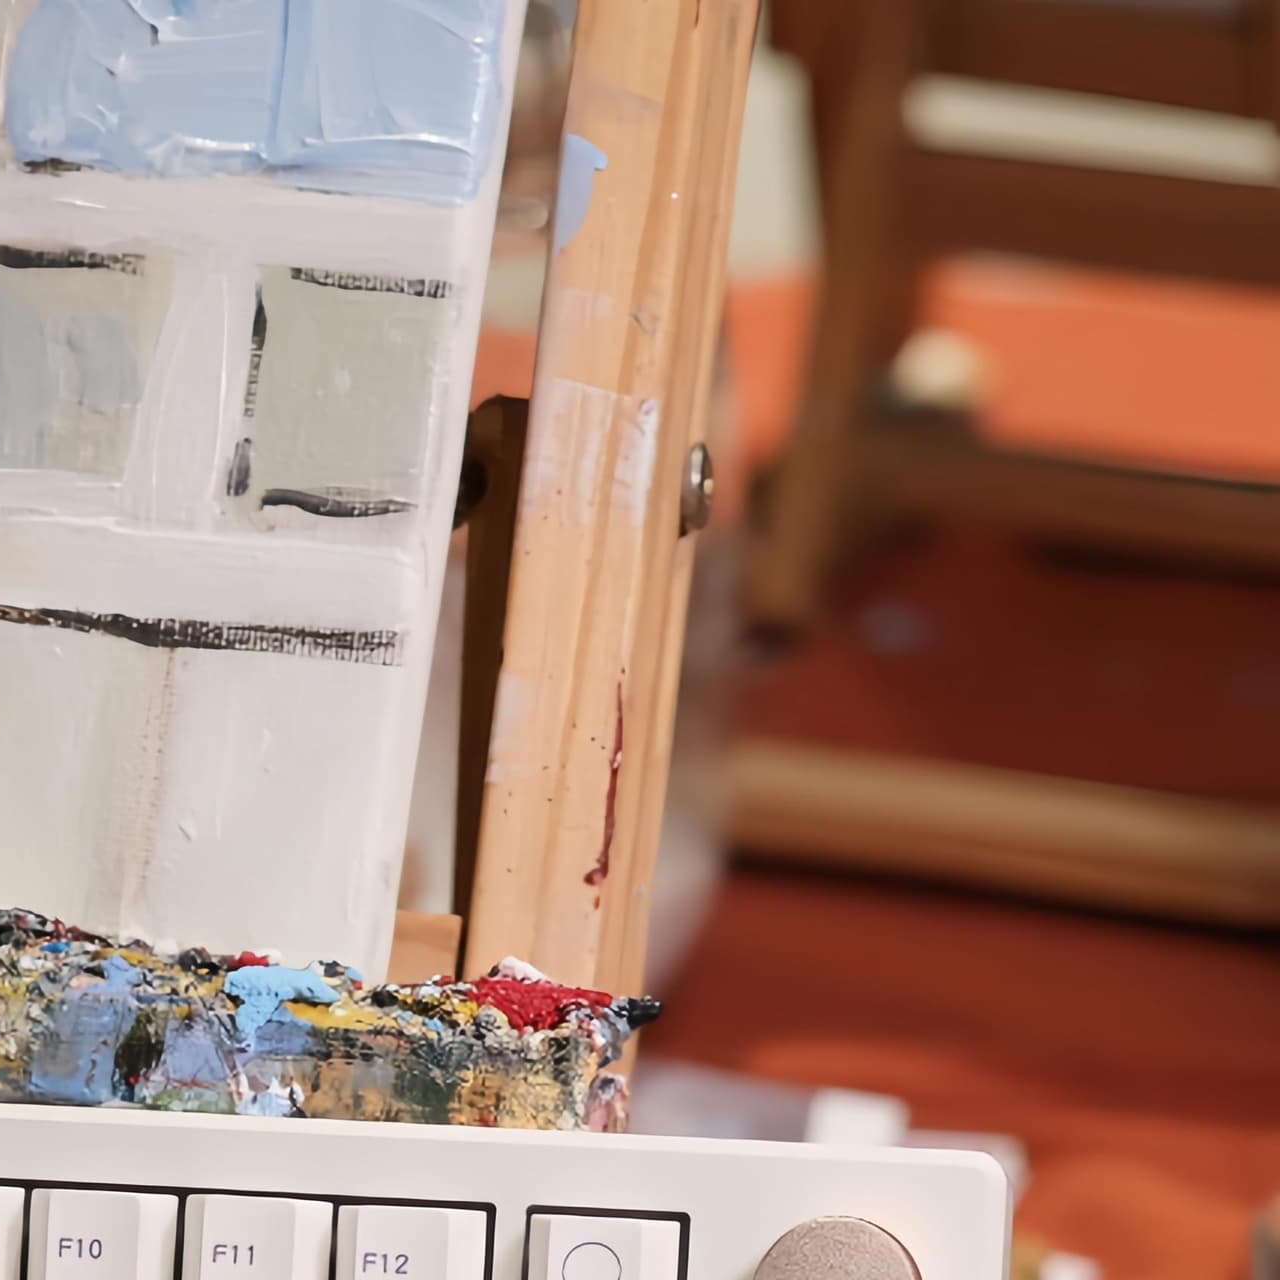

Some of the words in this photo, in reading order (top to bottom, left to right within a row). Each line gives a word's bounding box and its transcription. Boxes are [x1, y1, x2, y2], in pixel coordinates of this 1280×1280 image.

[58, 1237, 103, 1260] F10
[212, 1244, 254, 1266] F11
[362, 1252, 409, 1275] F12
